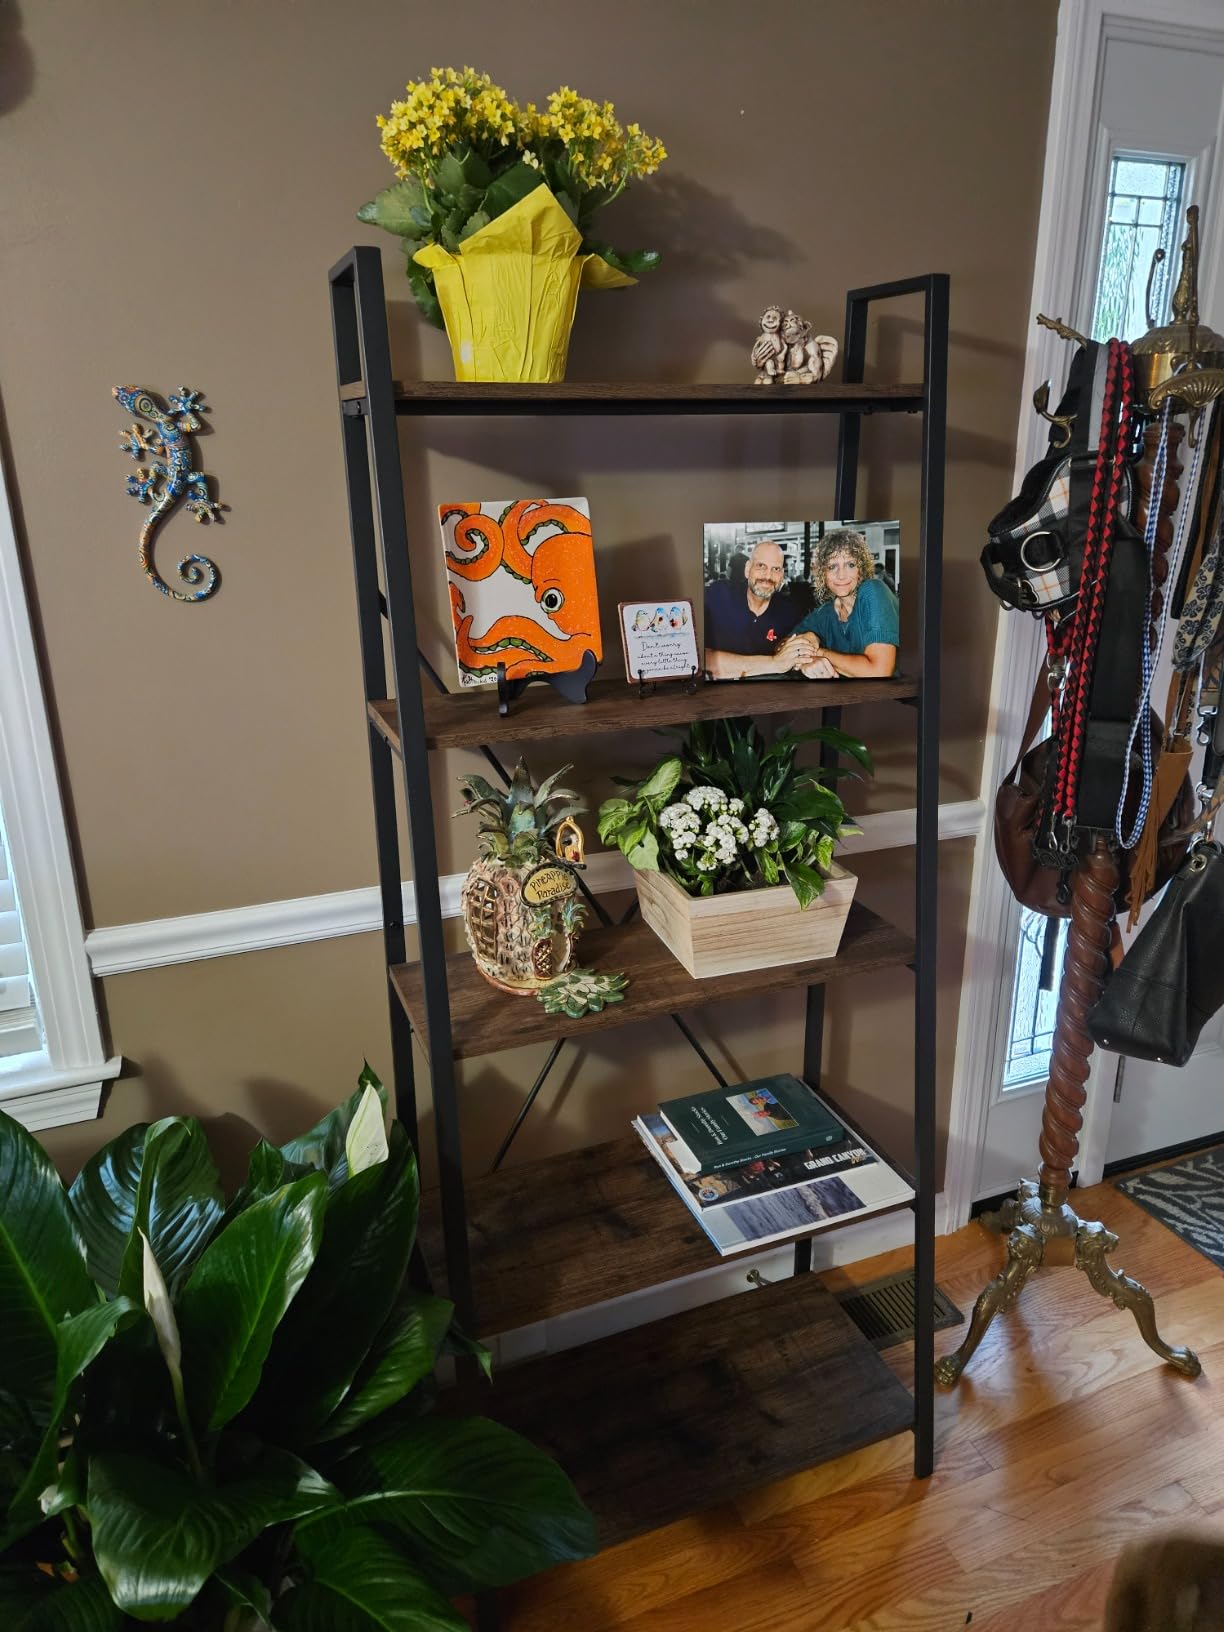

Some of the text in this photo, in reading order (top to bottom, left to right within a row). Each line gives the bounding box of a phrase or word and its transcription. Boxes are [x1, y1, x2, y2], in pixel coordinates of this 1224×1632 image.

[536, 881, 571, 899] Paradise
[803, 1156, 835, 1170] GRAND
[831, 1147, 867, 1163] CANYON
